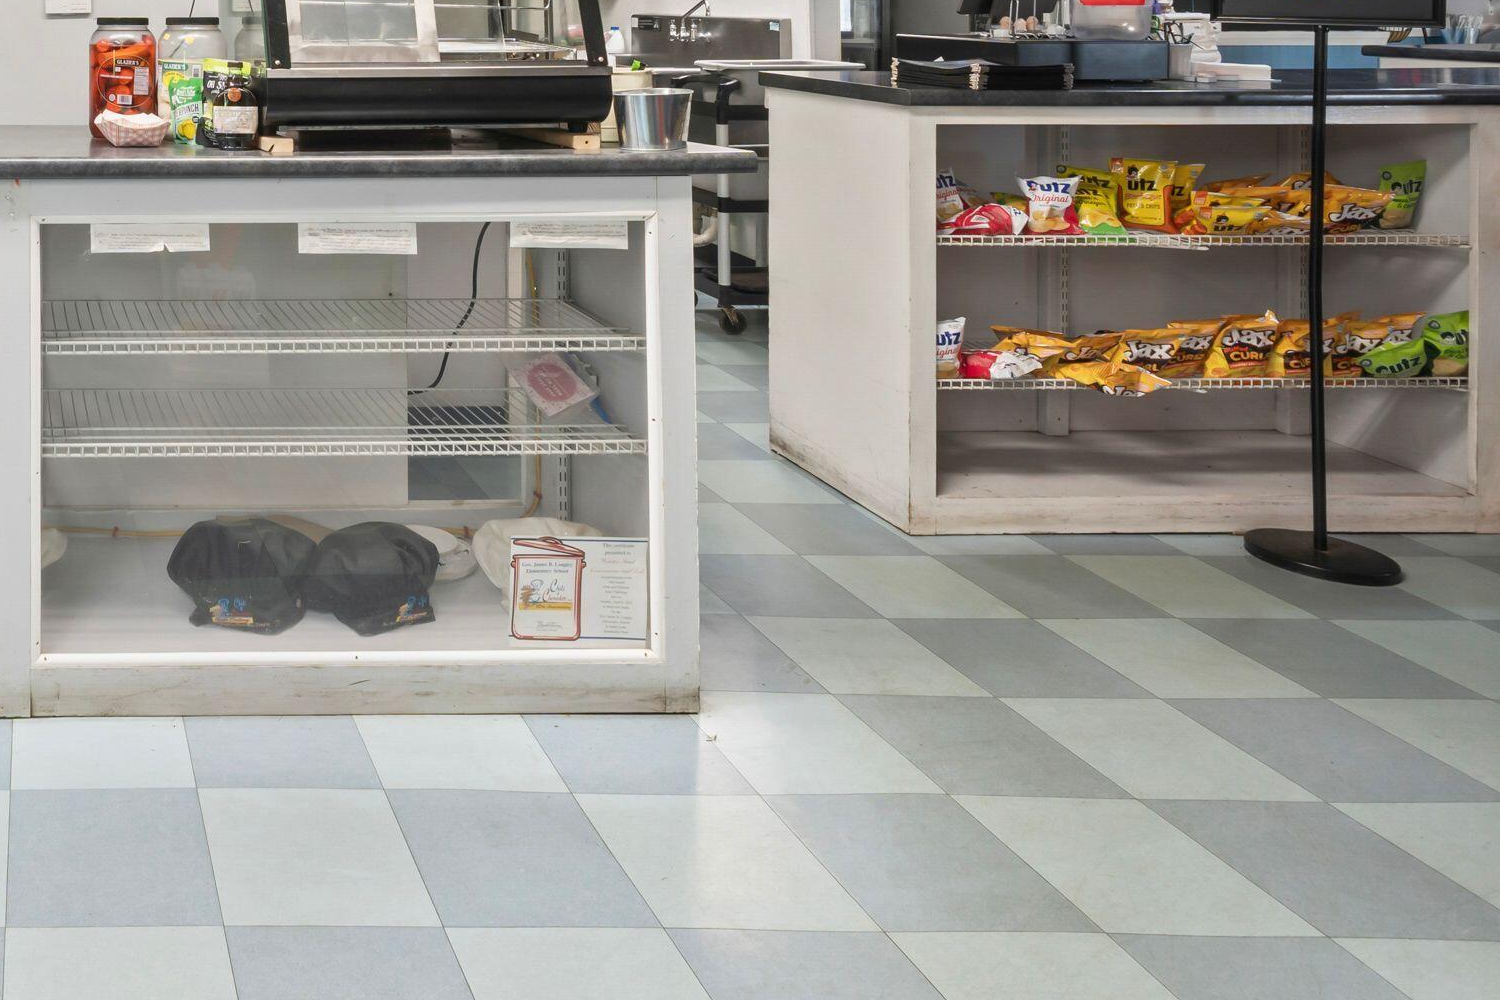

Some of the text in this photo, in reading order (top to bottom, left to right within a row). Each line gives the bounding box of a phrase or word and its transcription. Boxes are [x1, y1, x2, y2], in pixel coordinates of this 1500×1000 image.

[1329, 203, 1379, 222] Jax
[1223, 329, 1276, 347] Jax
[1124, 340, 1174, 361] Jax
